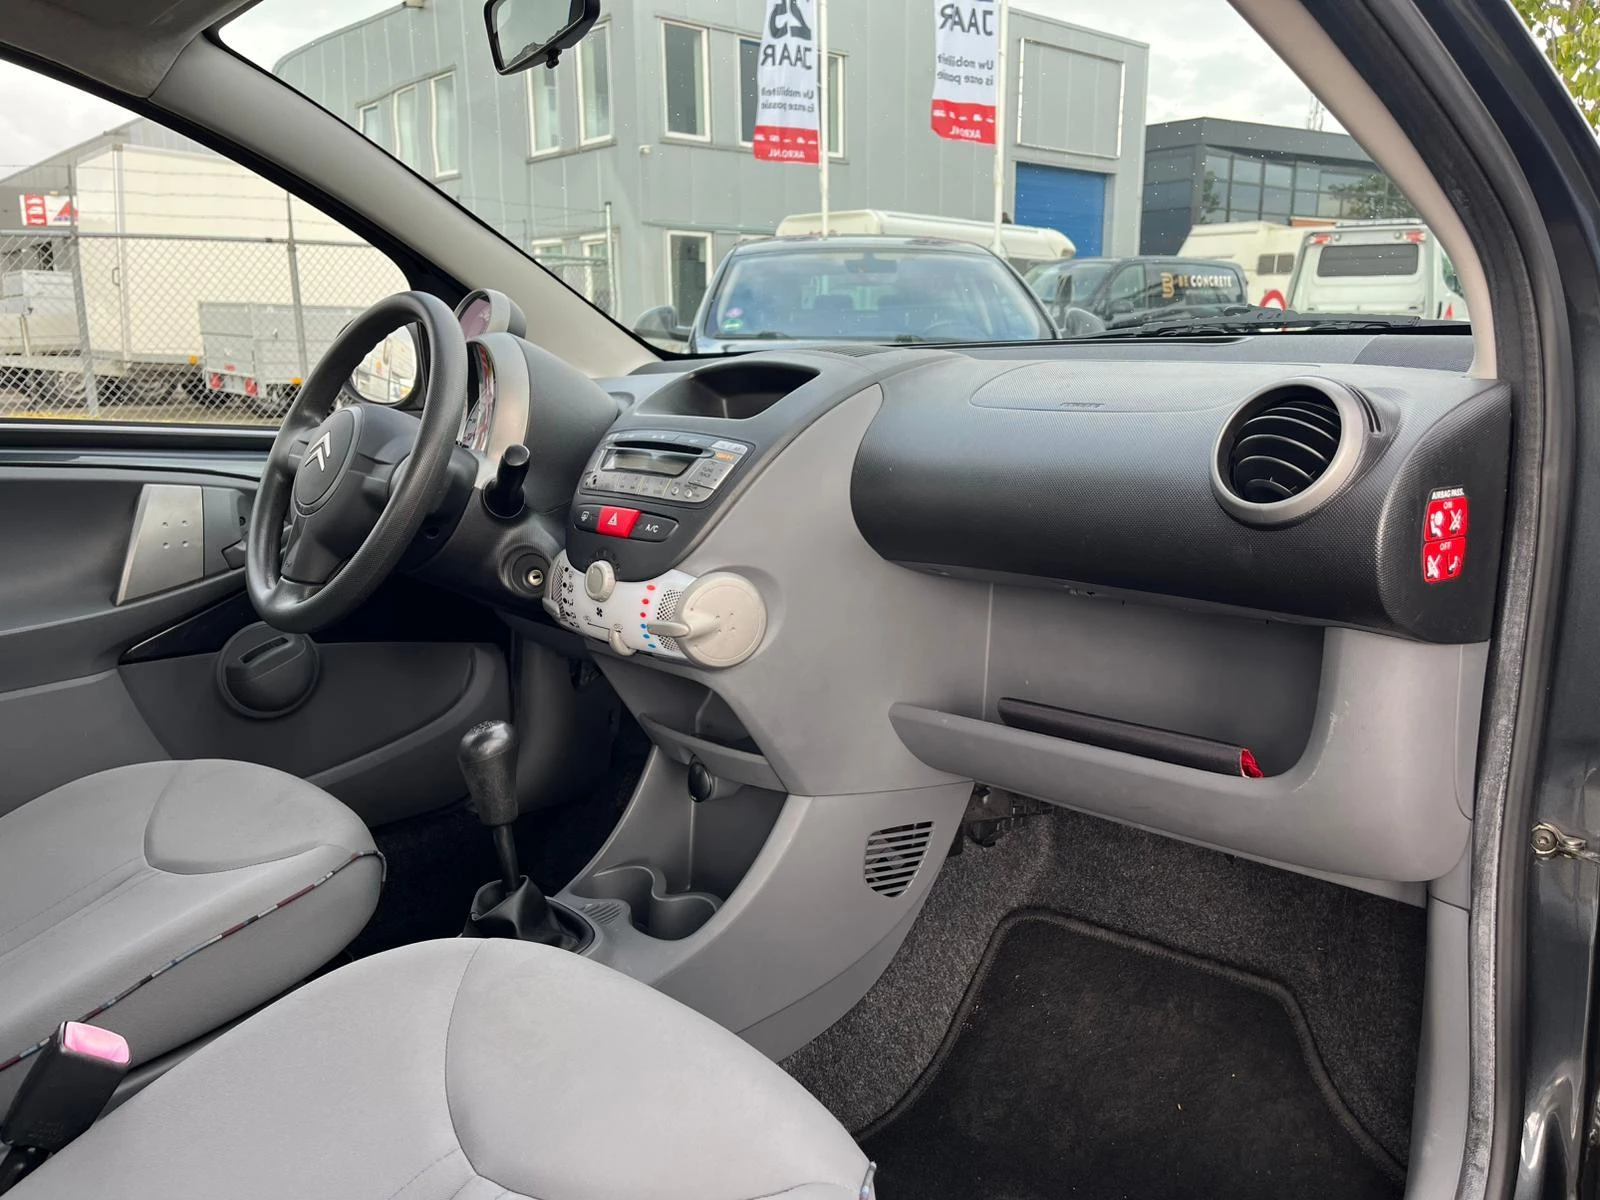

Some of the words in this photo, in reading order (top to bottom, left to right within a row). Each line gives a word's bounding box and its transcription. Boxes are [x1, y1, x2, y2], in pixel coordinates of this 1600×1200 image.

[1190, 275, 1232, 287] CONCRETE
[1443, 501, 1453, 509] ON
[645, 523, 659, 533] A/C
[1440, 542, 1451, 550] OFF
